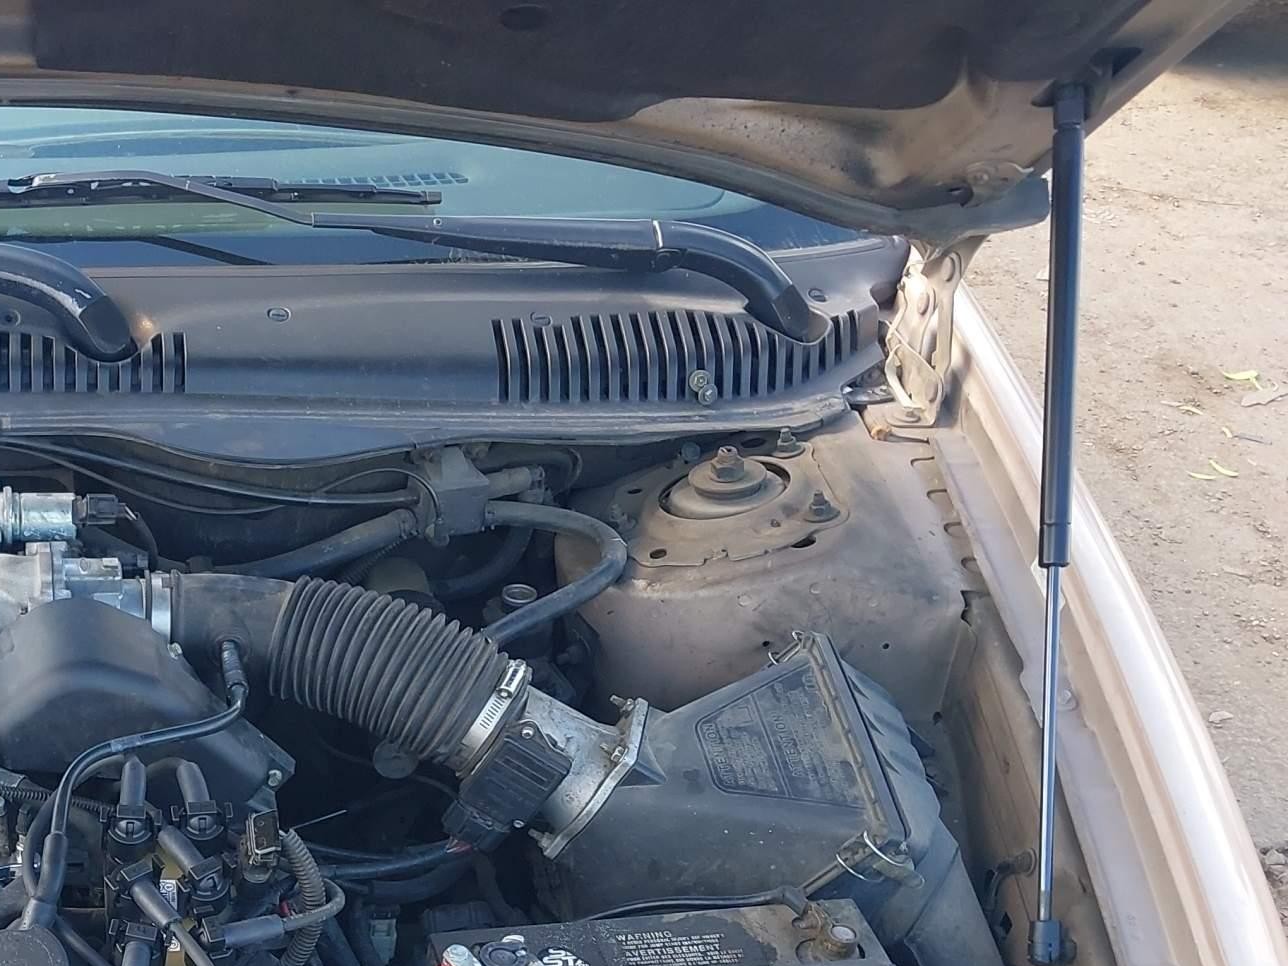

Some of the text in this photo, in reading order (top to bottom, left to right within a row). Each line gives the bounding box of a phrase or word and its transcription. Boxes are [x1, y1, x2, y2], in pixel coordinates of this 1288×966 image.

[768, 711, 805, 777] ATTENTION
[616, 931, 672, 941] WARNING
[625, 944, 720, 957] AVERTISSEMENT
